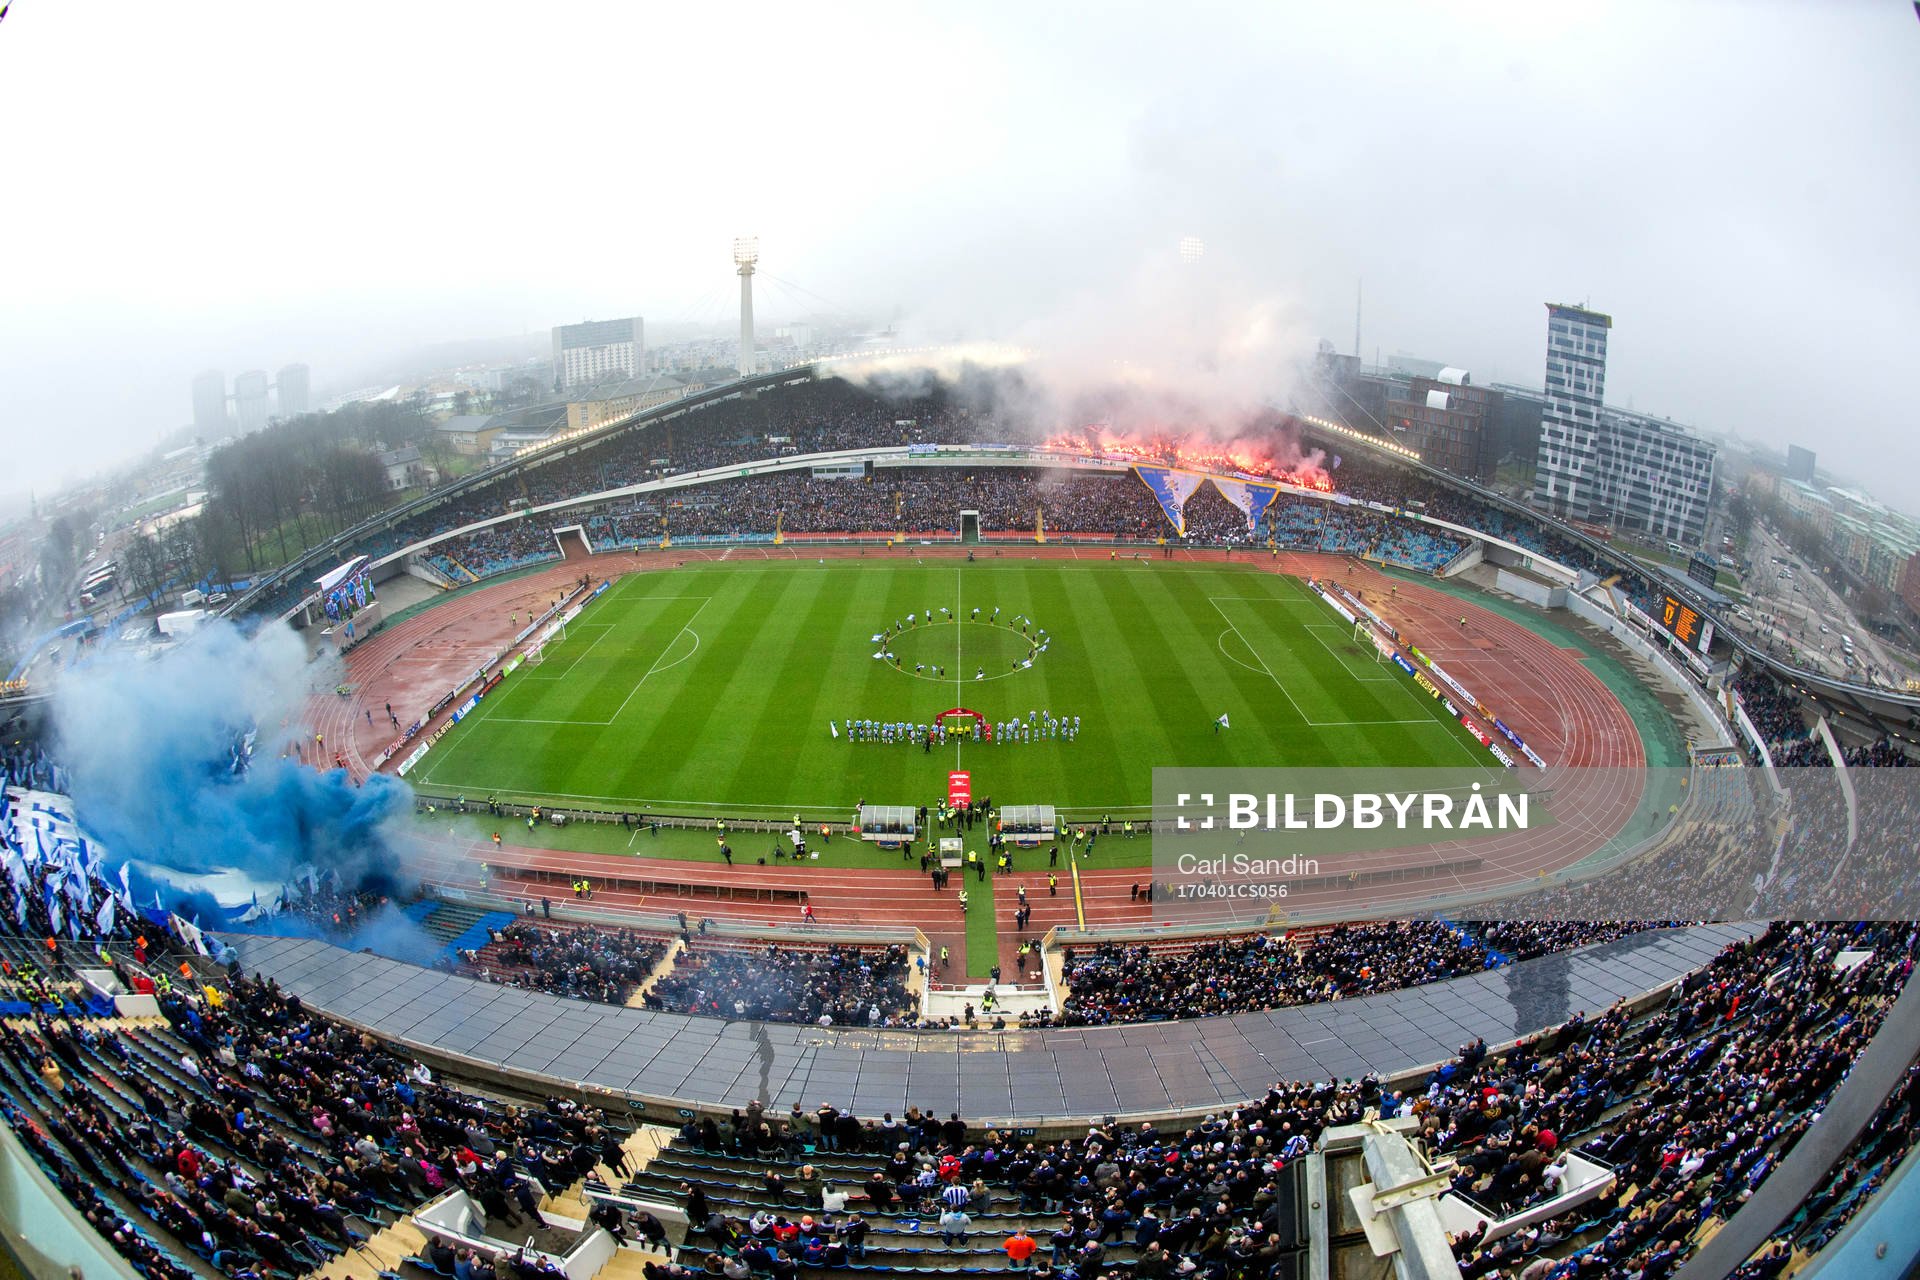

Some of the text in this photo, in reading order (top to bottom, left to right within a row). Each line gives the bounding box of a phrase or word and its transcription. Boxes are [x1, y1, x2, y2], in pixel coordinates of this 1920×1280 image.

[434, 718, 455, 740] XL-BYGG
[1465, 720, 1485, 743] Scandic
[1489, 743, 1515, 769] SERNEKE
